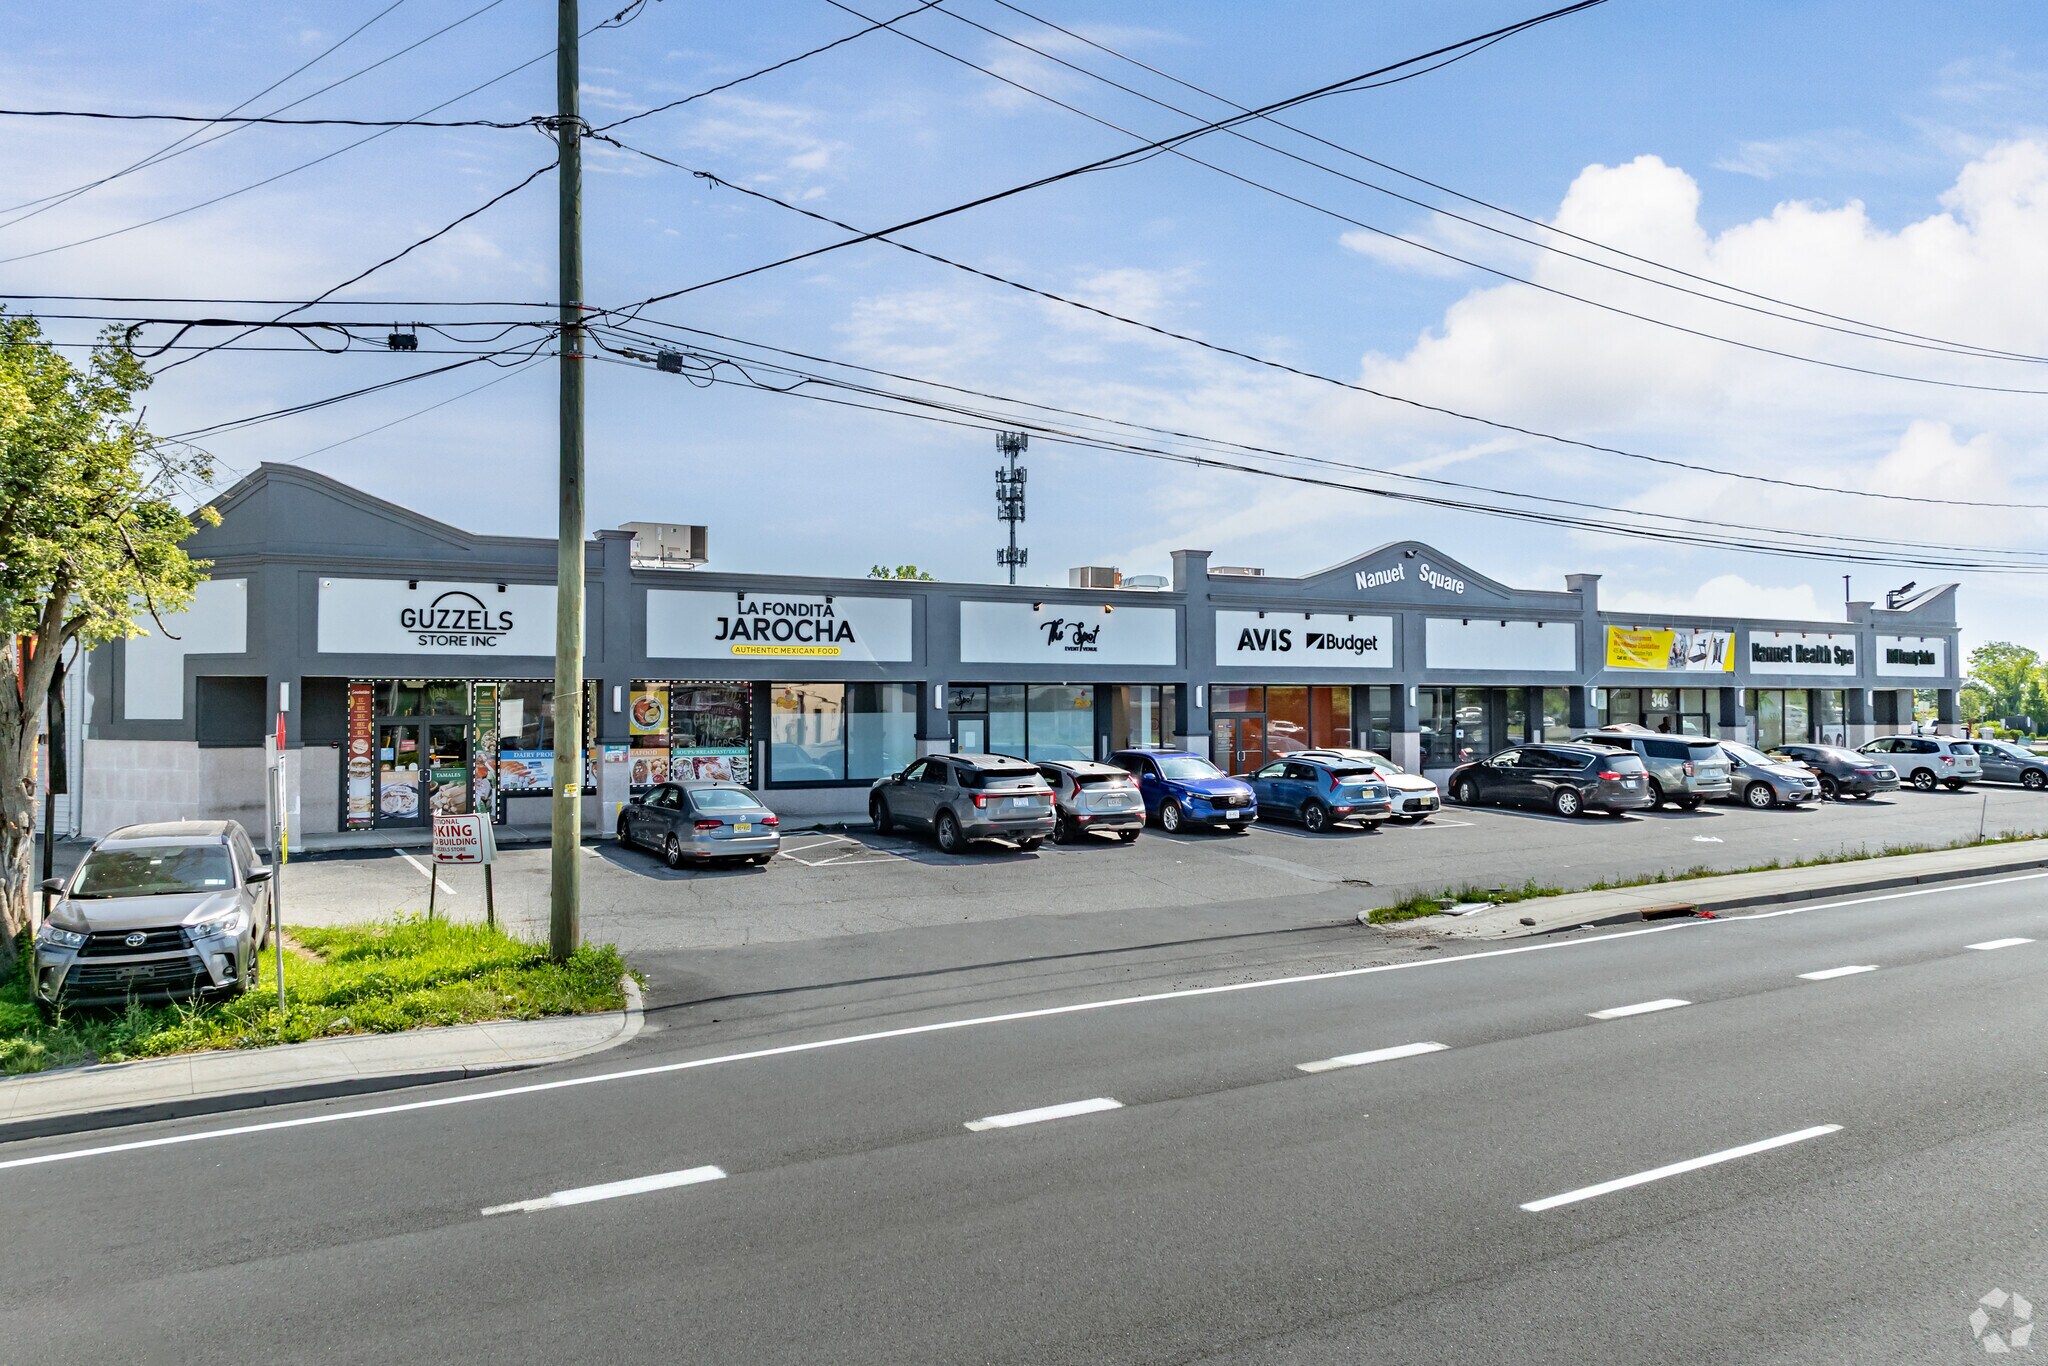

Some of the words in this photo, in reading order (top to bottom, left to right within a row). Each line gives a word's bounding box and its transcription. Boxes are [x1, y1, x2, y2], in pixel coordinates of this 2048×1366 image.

[1355, 563, 1405, 590] Nanuet
[1419, 563, 1465, 594] Square
[401, 608, 513, 630] GUZZELS
[738, 601, 759, 615] LA
[762, 602, 835, 617] FONDITA
[418, 635, 467, 646] STORE
[471, 636, 497, 647] INC
[715, 617, 855, 643] JAROCHA
[1040, 618, 1064, 646] The
[1065, 621, 1100, 652] Spot
[1237, 628, 1292, 652] AVIS
[735, 646, 778, 654] AUTHENTIC
[780, 646, 815, 654] MEXICAN
[1326, 633, 1378, 656] Budget
[1752, 643, 1793, 663] Nanuet
[1796, 644, 1832, 664] Health
[1834, 645, 1855, 666] Spa
[1651, 693, 1669, 708] 346
[439, 837, 477, 846] BUILDING
